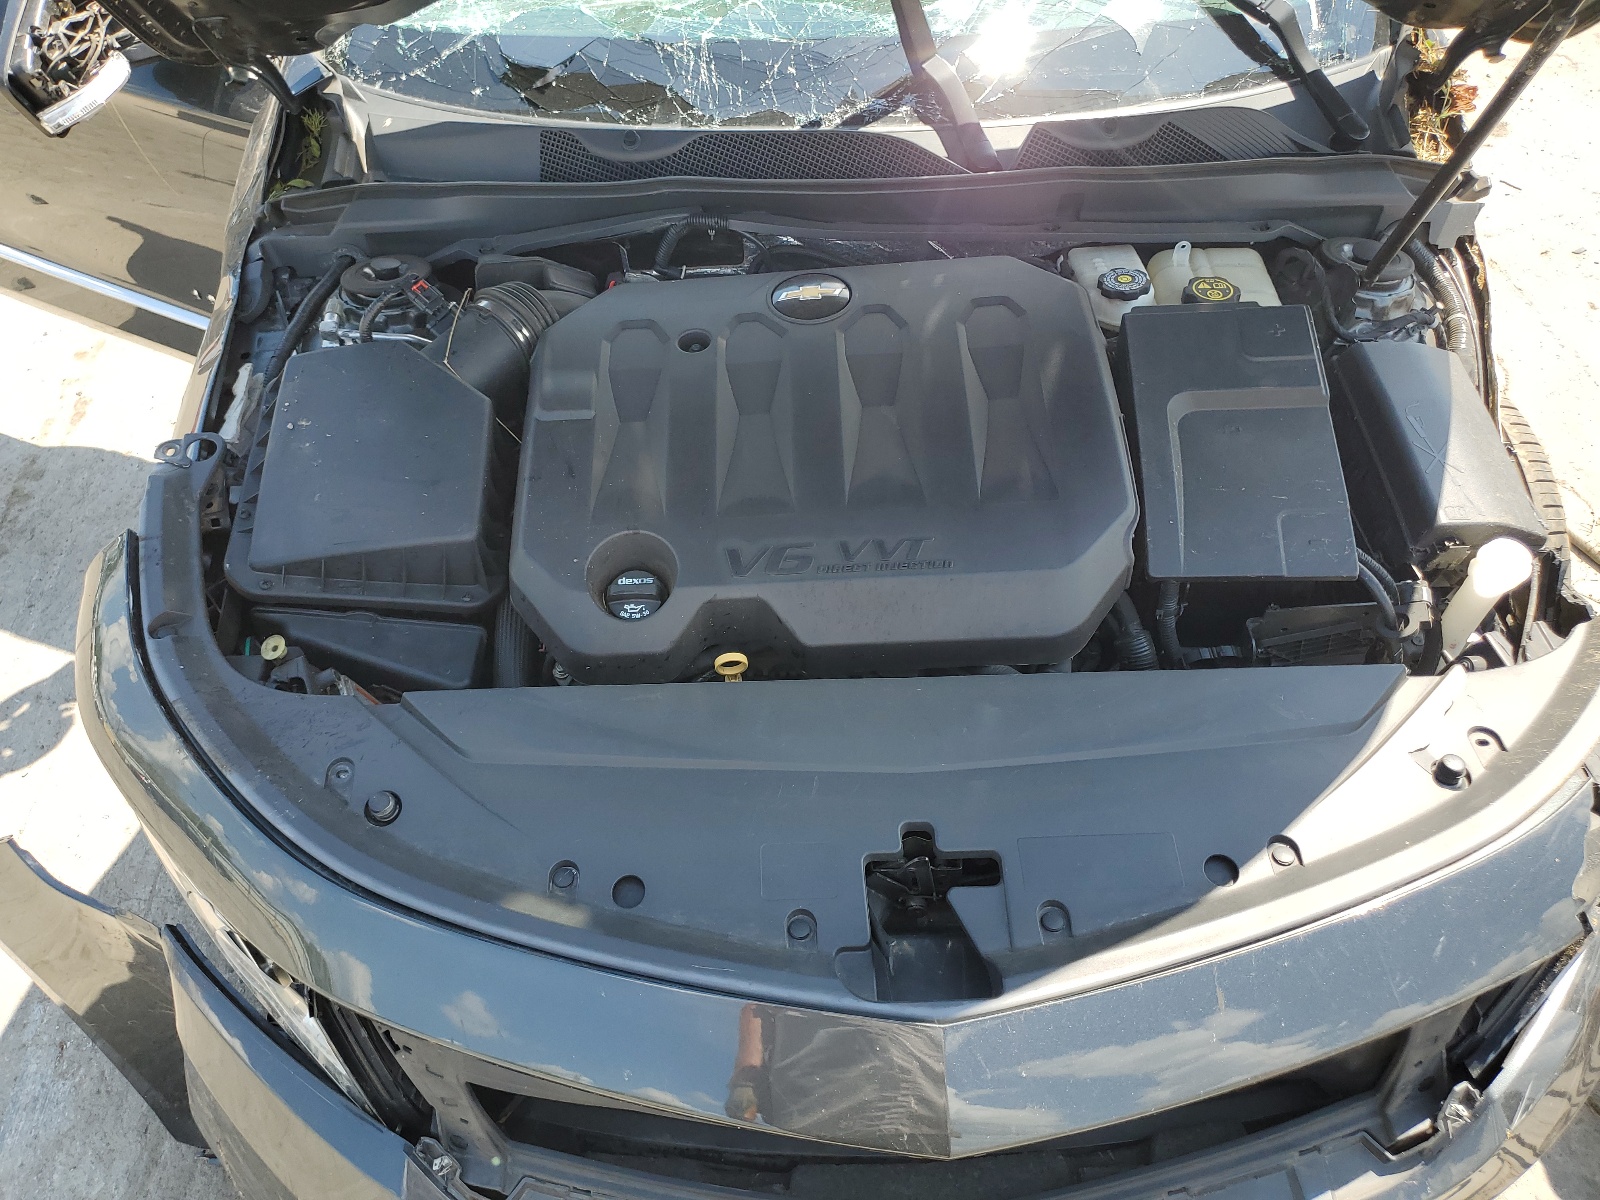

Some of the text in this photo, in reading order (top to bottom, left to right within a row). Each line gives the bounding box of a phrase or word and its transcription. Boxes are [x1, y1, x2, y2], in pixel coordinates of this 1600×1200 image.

[724, 537, 935, 578] V6 VVT
[816, 559, 955, 575] DIRECT INJECTION
[617, 577, 655, 585] dexos
